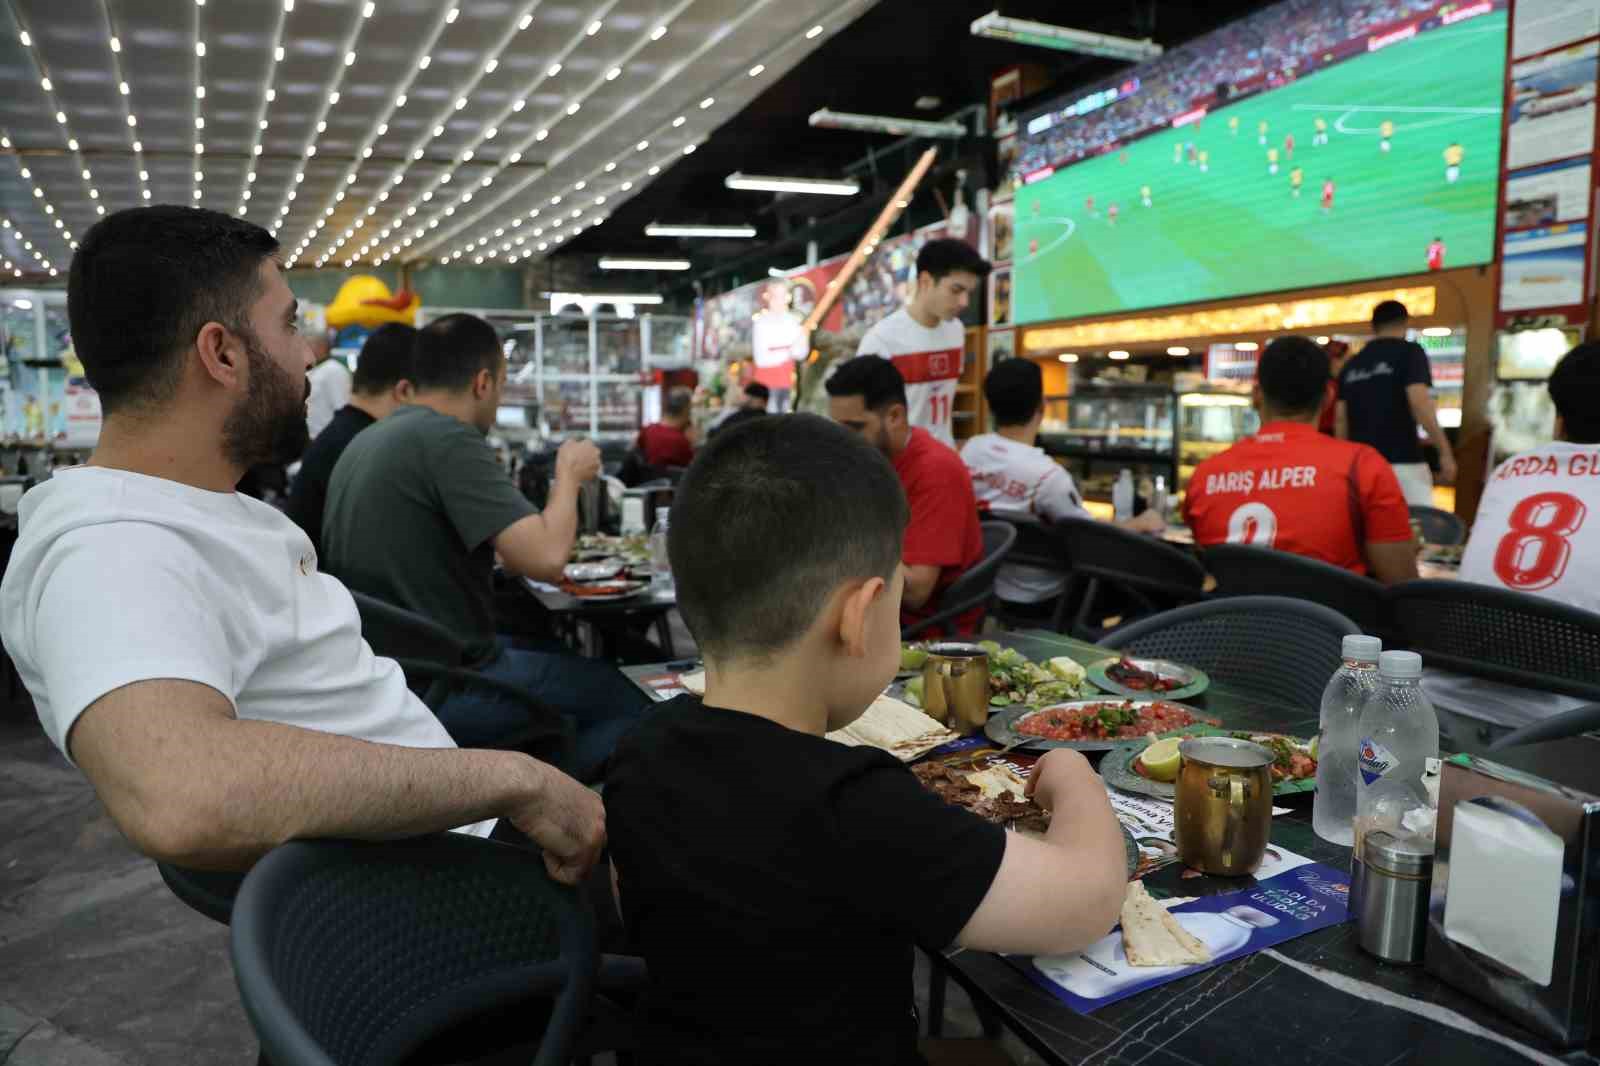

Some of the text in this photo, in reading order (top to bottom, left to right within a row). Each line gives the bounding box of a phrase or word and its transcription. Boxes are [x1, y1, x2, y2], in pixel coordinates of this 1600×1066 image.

[929, 394, 950, 425] 11
[1205, 465, 1316, 496] BARIŞ ALPER
[1493, 491, 1587, 592] 8
